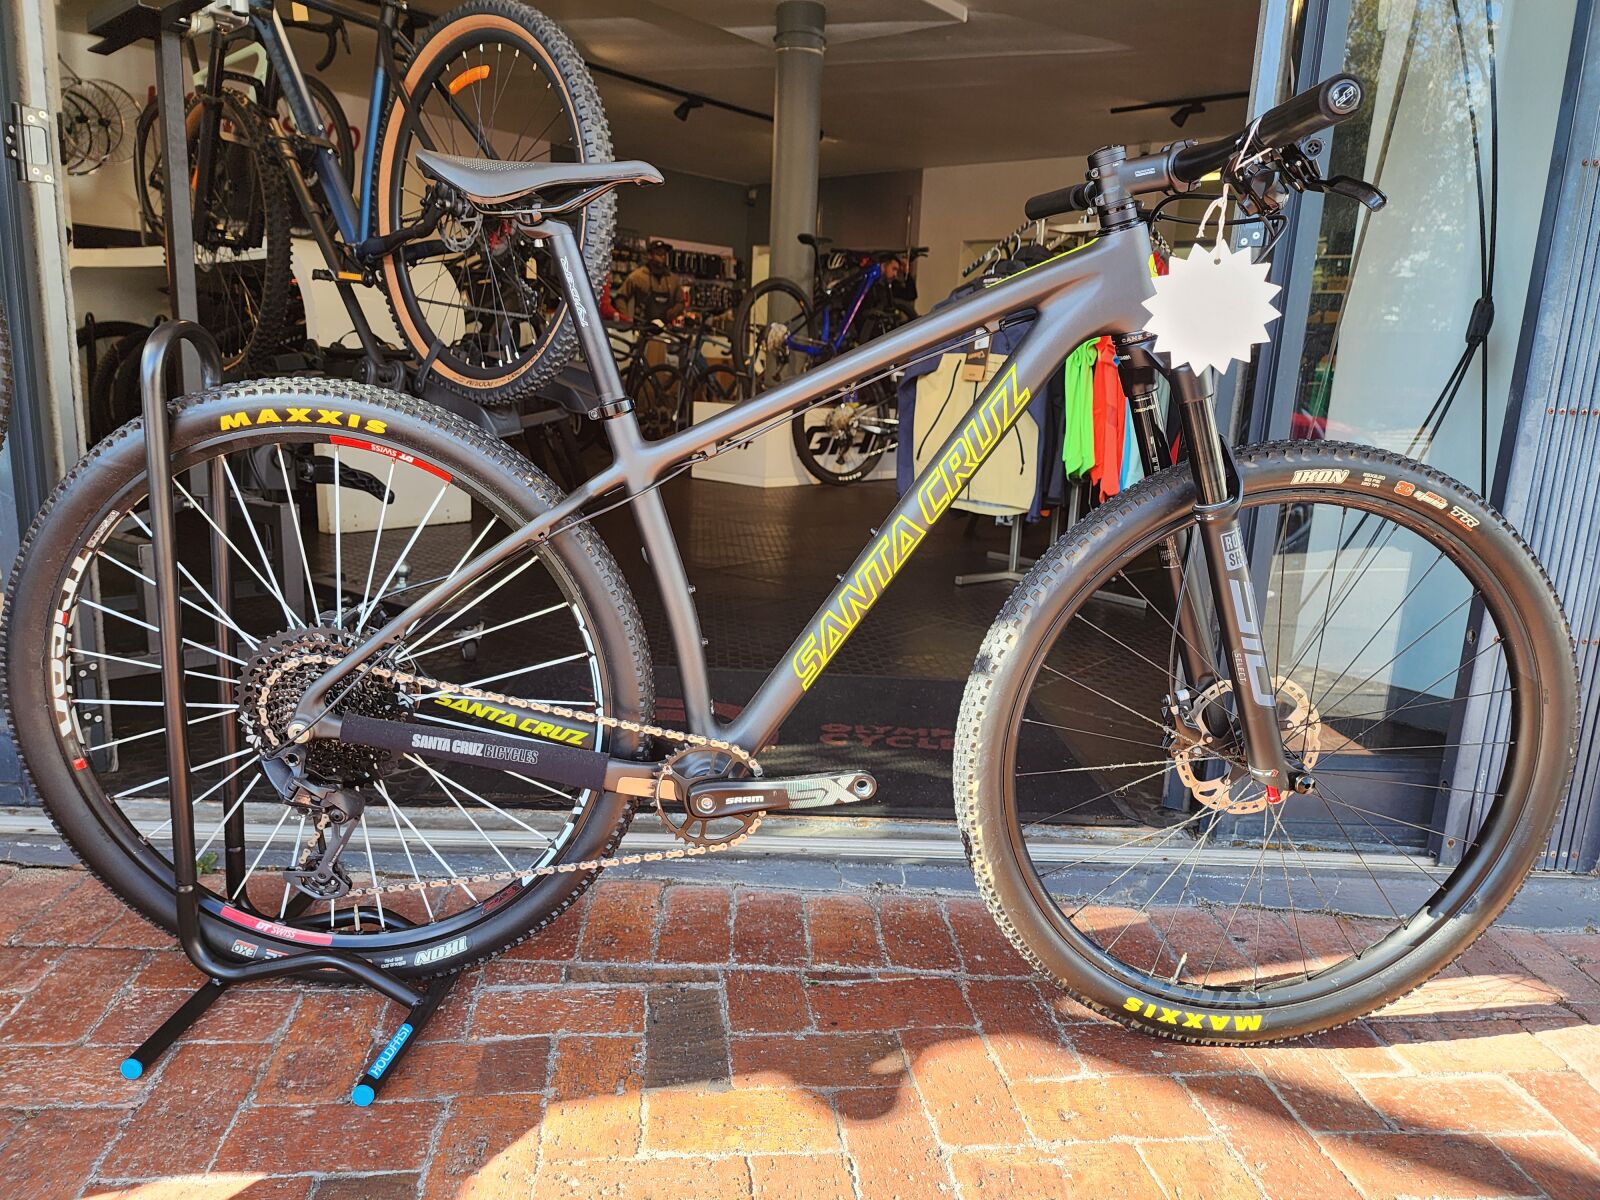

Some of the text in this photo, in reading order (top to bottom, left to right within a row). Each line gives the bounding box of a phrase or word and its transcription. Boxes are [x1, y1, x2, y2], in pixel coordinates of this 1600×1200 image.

[220, 408, 388, 434] MAXXIS
[371, 444, 414, 463] DT SWISS
[1290, 469, 1349, 485] IKON
[793, 363, 1031, 692] SANTA CRUZ
[1234, 653, 1247, 683] SELECT
[434, 694, 589, 745] SANTA CRUZ
[820, 722, 954, 738] OLYMP
[411, 733, 539, 765] SANTA CRUZ BICYCLES
[820, 733, 956, 750] CYCLE
[725, 795, 765, 805] SRAM
[255, 921, 297, 938] DT SWISS
[414, 936, 468, 966] IKON
[1123, 997, 1262, 1032] MAXXIS
